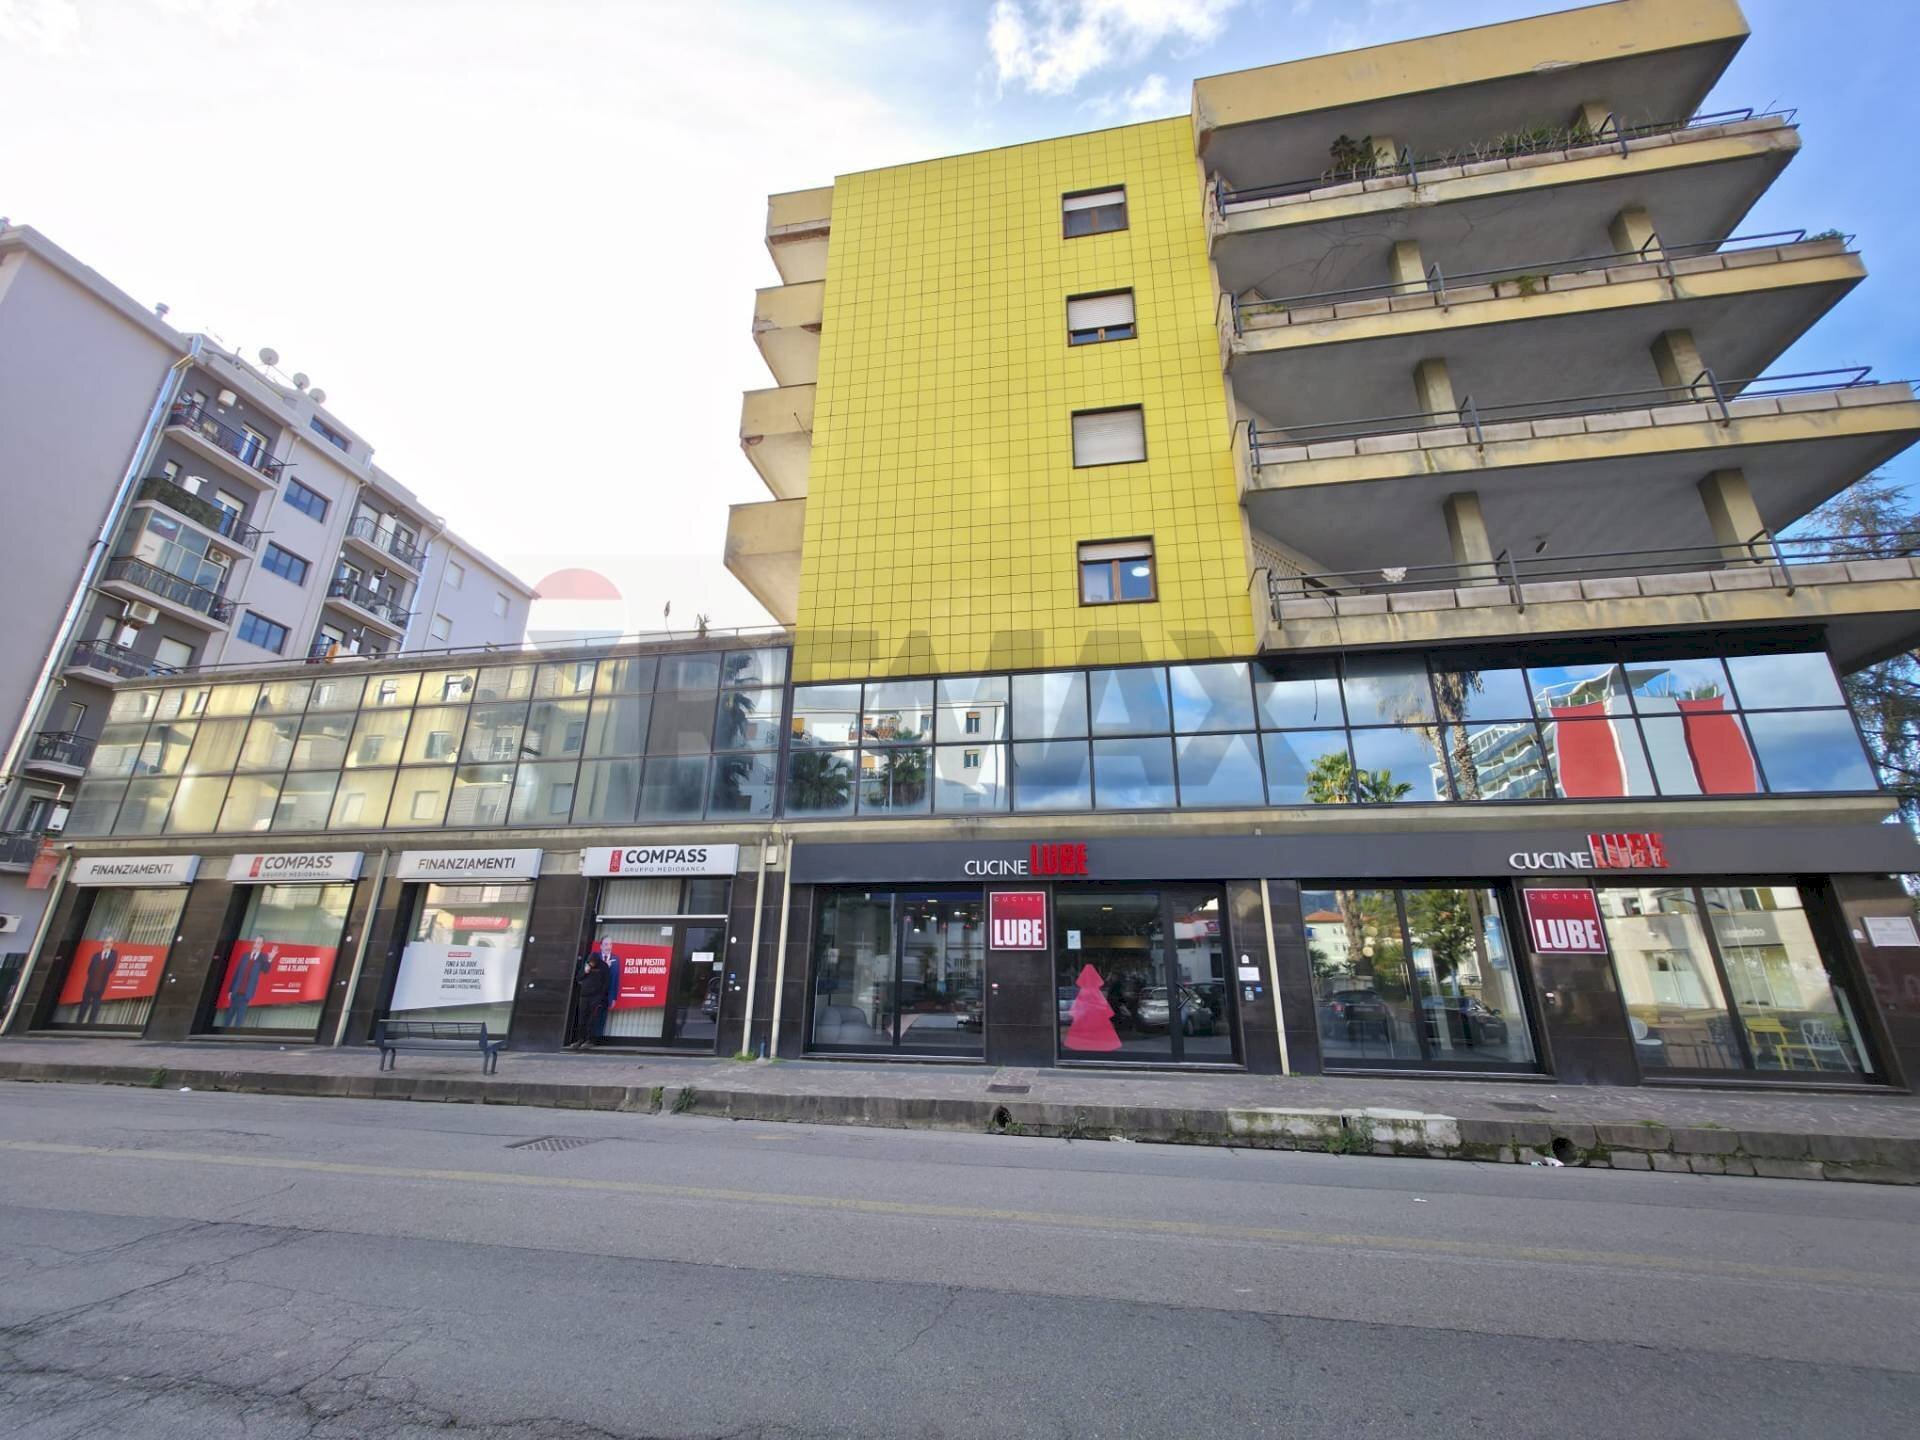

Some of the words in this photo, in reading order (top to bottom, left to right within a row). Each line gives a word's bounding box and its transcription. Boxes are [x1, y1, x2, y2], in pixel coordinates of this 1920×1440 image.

[625, 848, 708, 865] COMPASS
[1509, 851, 1594, 870] CUCINE
[1586, 832, 1671, 869] LUBE
[264, 855, 334, 870] COMPASS
[418, 857, 516, 870] FINANZIAMENTI
[964, 859, 1029, 876] CUCINE
[1029, 843, 1089, 877] LUBE
[90, 863, 175, 876] FINANZIAMENTI
[1529, 893, 1593, 901] CUCINE
[994, 918, 1043, 947] LUBE
[1535, 918, 1602, 950] LUBE
[643, 958, 666, 967] PRESTITO
